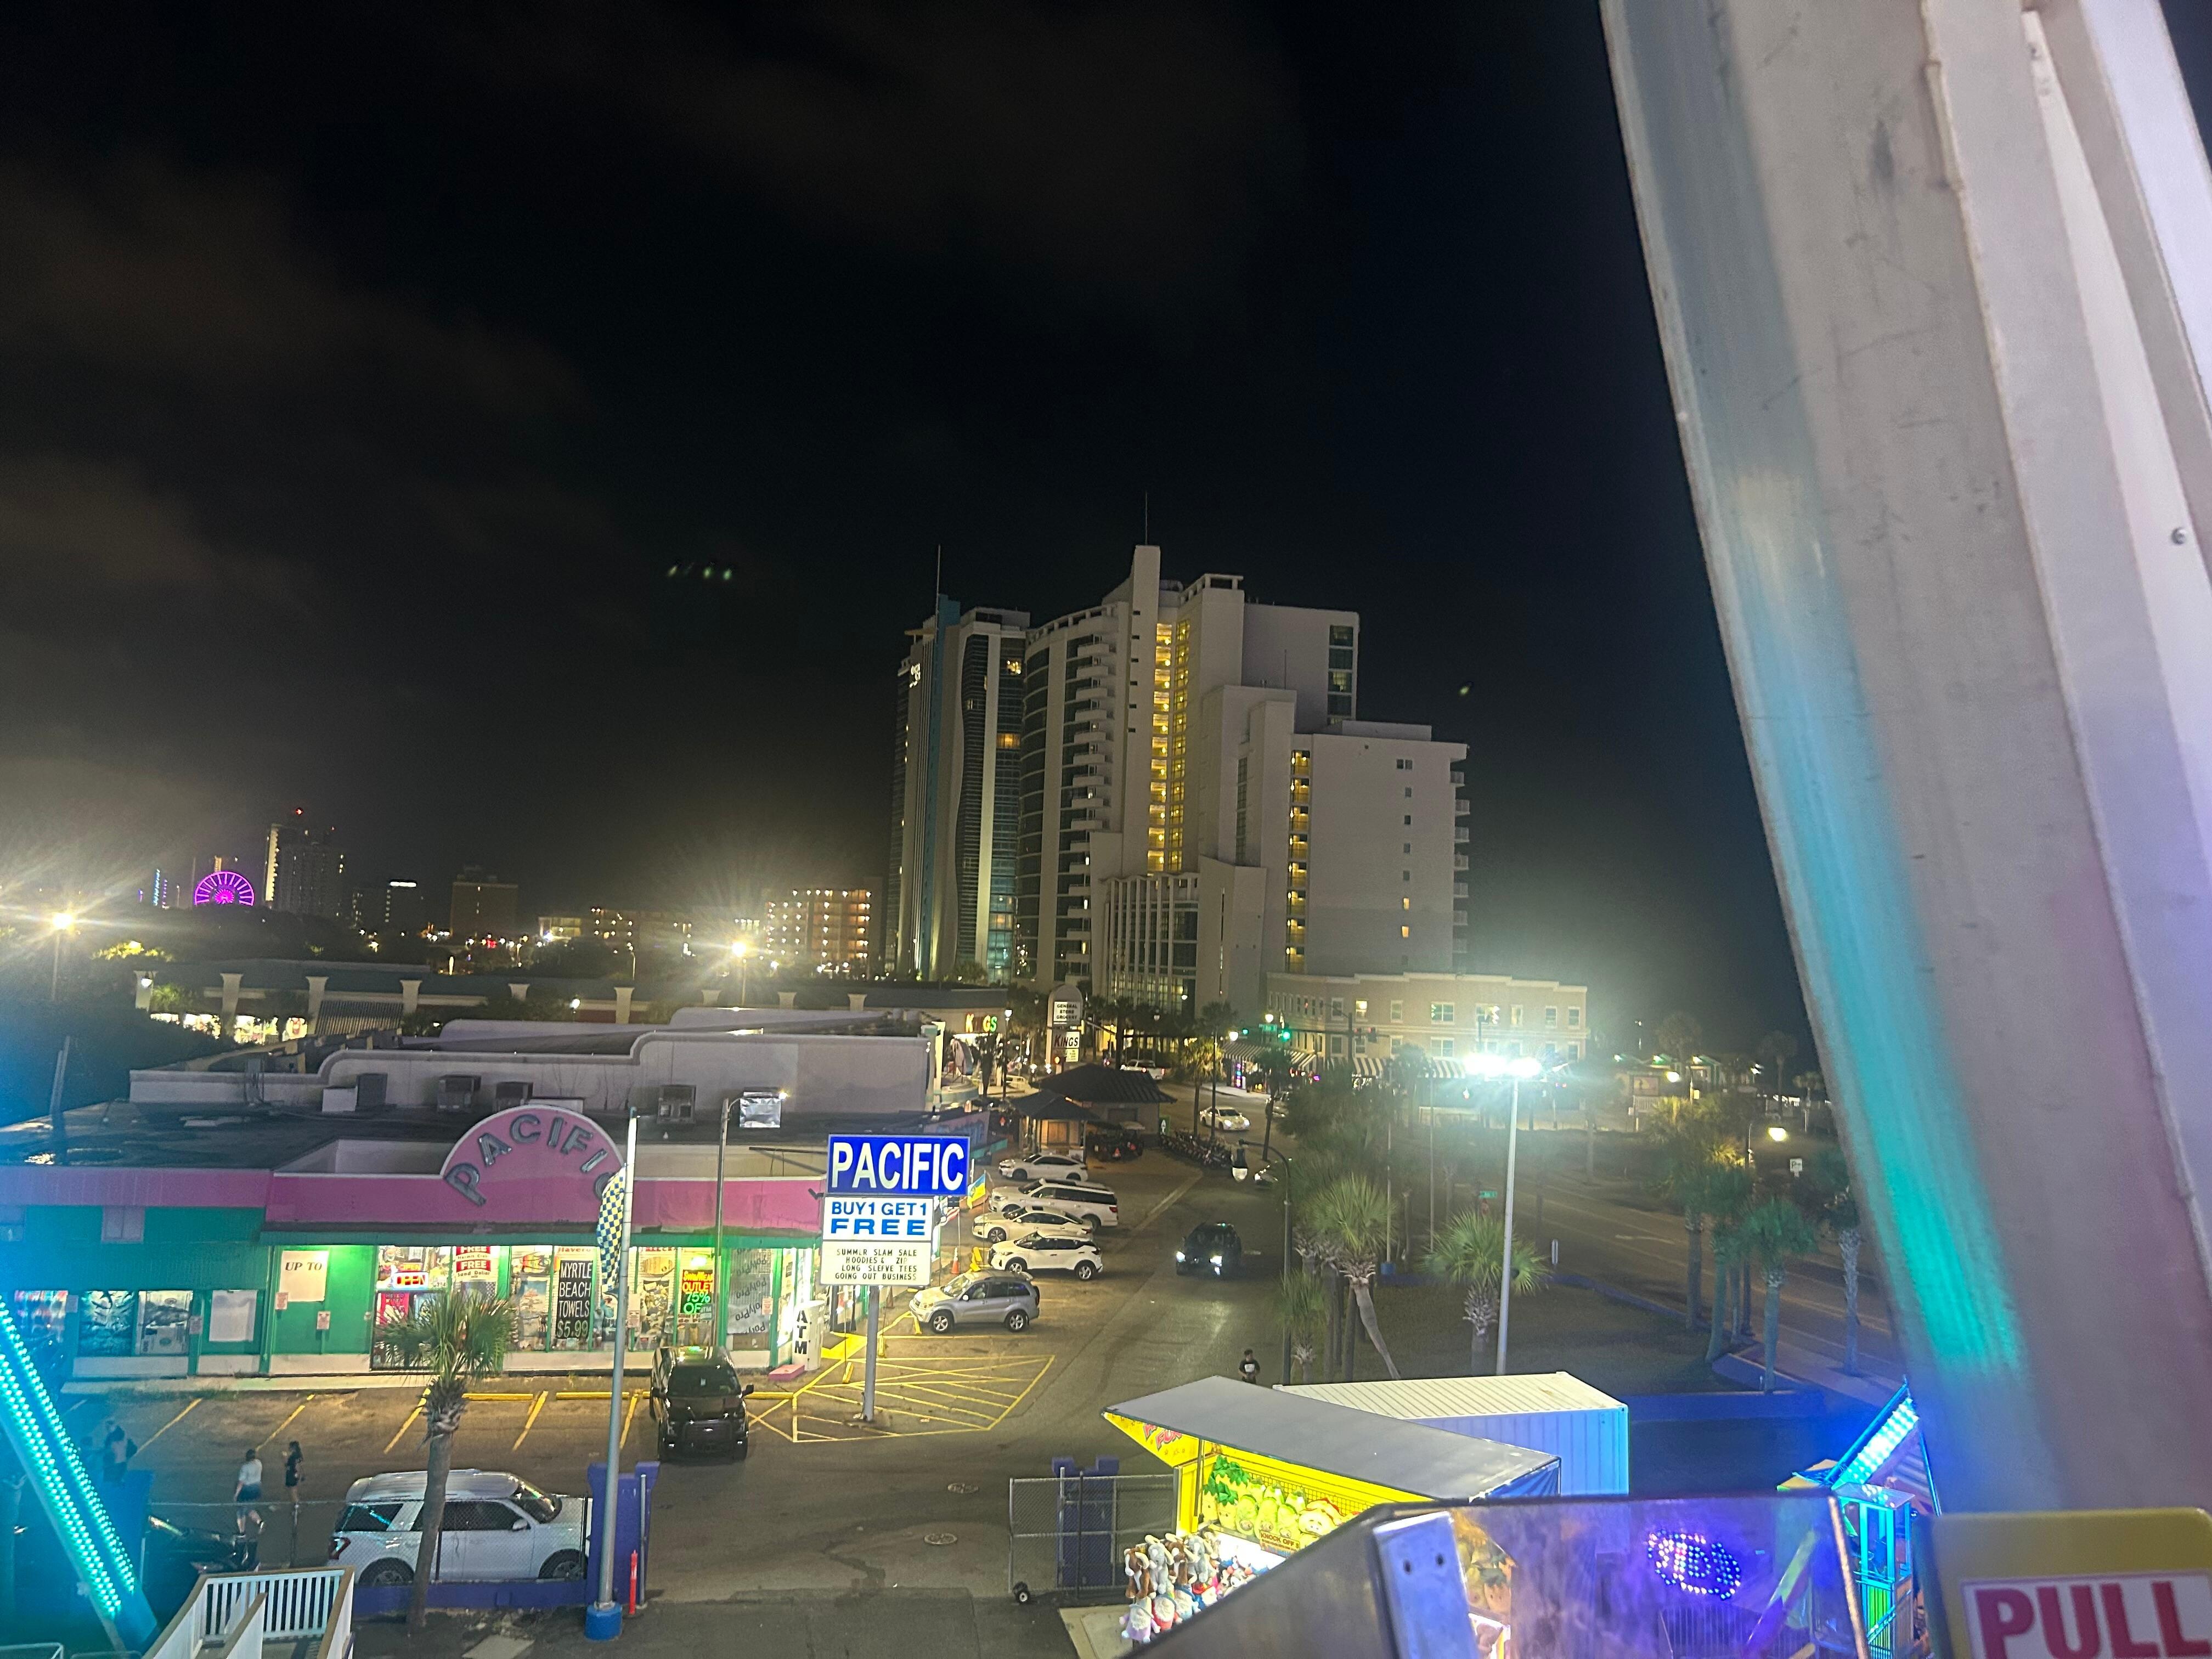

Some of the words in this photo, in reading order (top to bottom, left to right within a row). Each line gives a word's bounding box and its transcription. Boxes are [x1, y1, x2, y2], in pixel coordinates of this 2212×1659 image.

[1054, 1034, 1079, 1047] KINGS
[831, 1142, 965, 1191] PACIFIC
[830, 1218, 926, 1235] FREE
[873, 1248, 893, 1256] SLAM
[899, 1249, 917, 1257] SALE
[285, 1262, 303, 1271] UP
[307, 1262, 323, 1271] TO
[461, 1260, 487, 1270] FREE
[560, 1262, 592, 1278] MYRTLE
[396, 1274, 426, 1286] OPEN
[882, 1273, 917, 1281] BUSINESS
[559, 1281, 591, 1297] BEACH
[682, 1282, 714, 1294] OUTLET
[685, 1291, 711, 1304] 75%
[558, 1300, 590, 1318] TOWELS
[557, 1319, 589, 1338] $5.99
[794, 1310, 809, 1355] ATM
[1260, 1532, 1281, 1543] KNOCK
[1282, 1538, 1295, 1547] OFF
[1975, 1580, 2212, 1659] PULL
